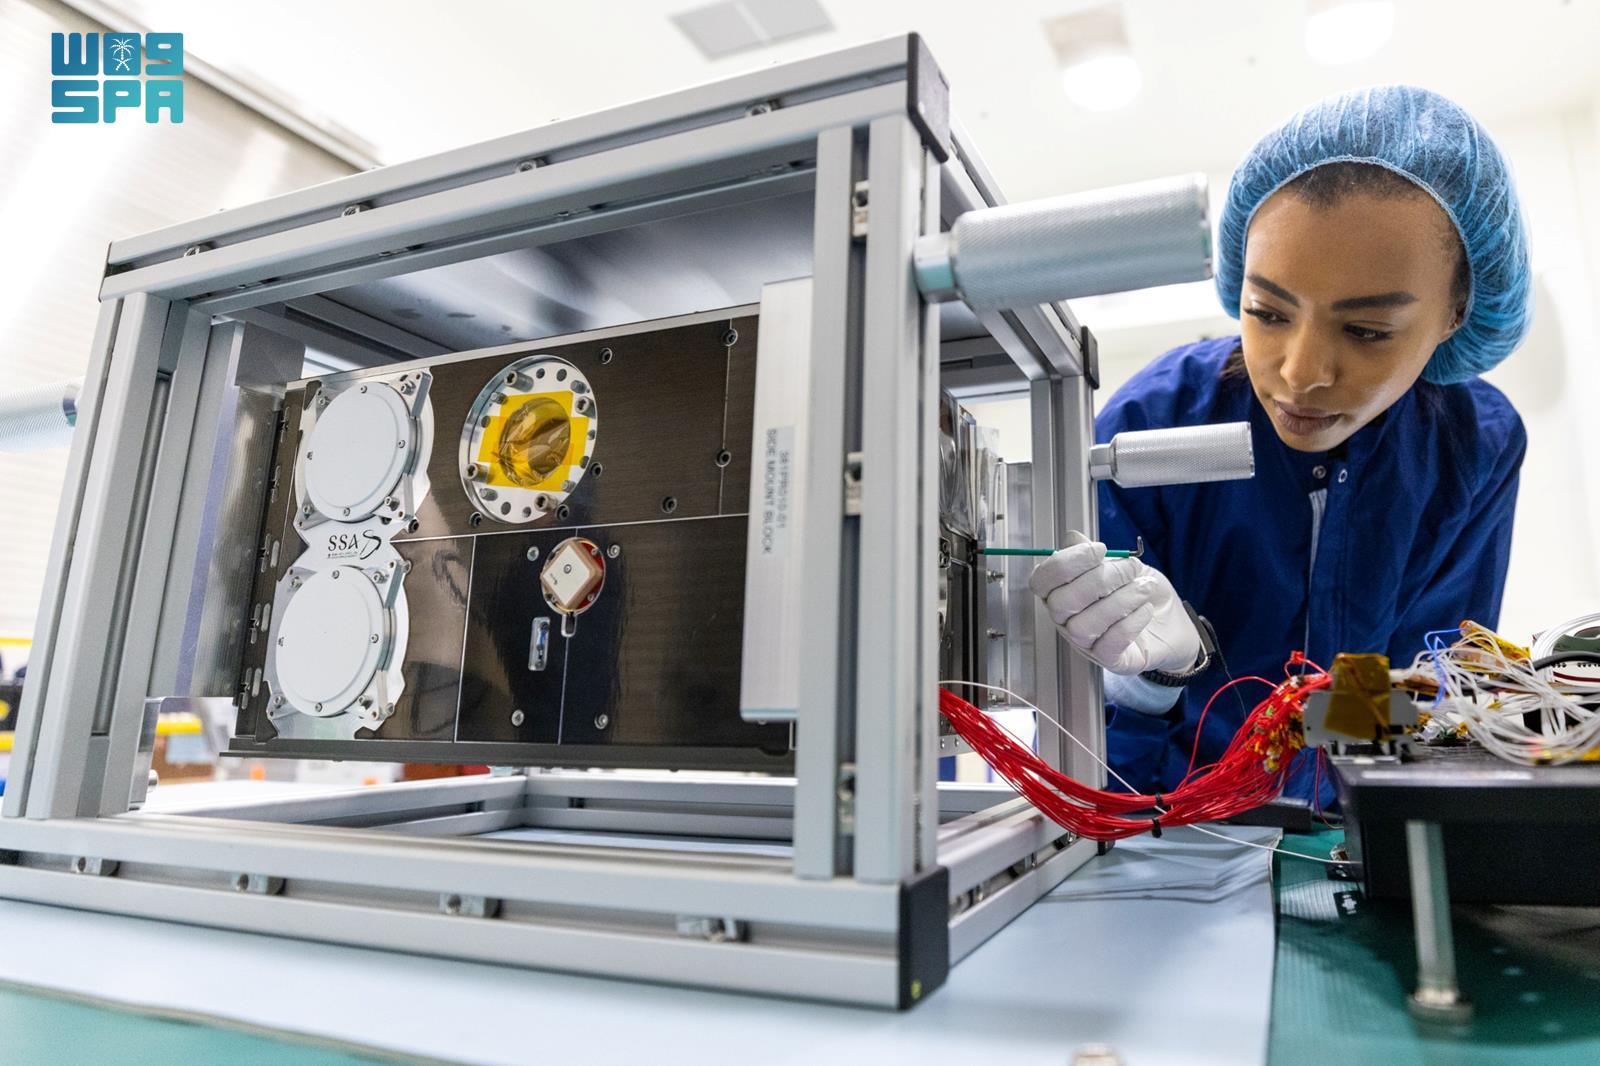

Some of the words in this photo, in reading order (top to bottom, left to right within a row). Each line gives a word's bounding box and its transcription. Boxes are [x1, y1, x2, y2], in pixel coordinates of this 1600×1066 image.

[766, 427, 777, 456] SIDE
[764, 459, 776, 506] MOUNT
[761, 510, 774, 555] BLOCK
